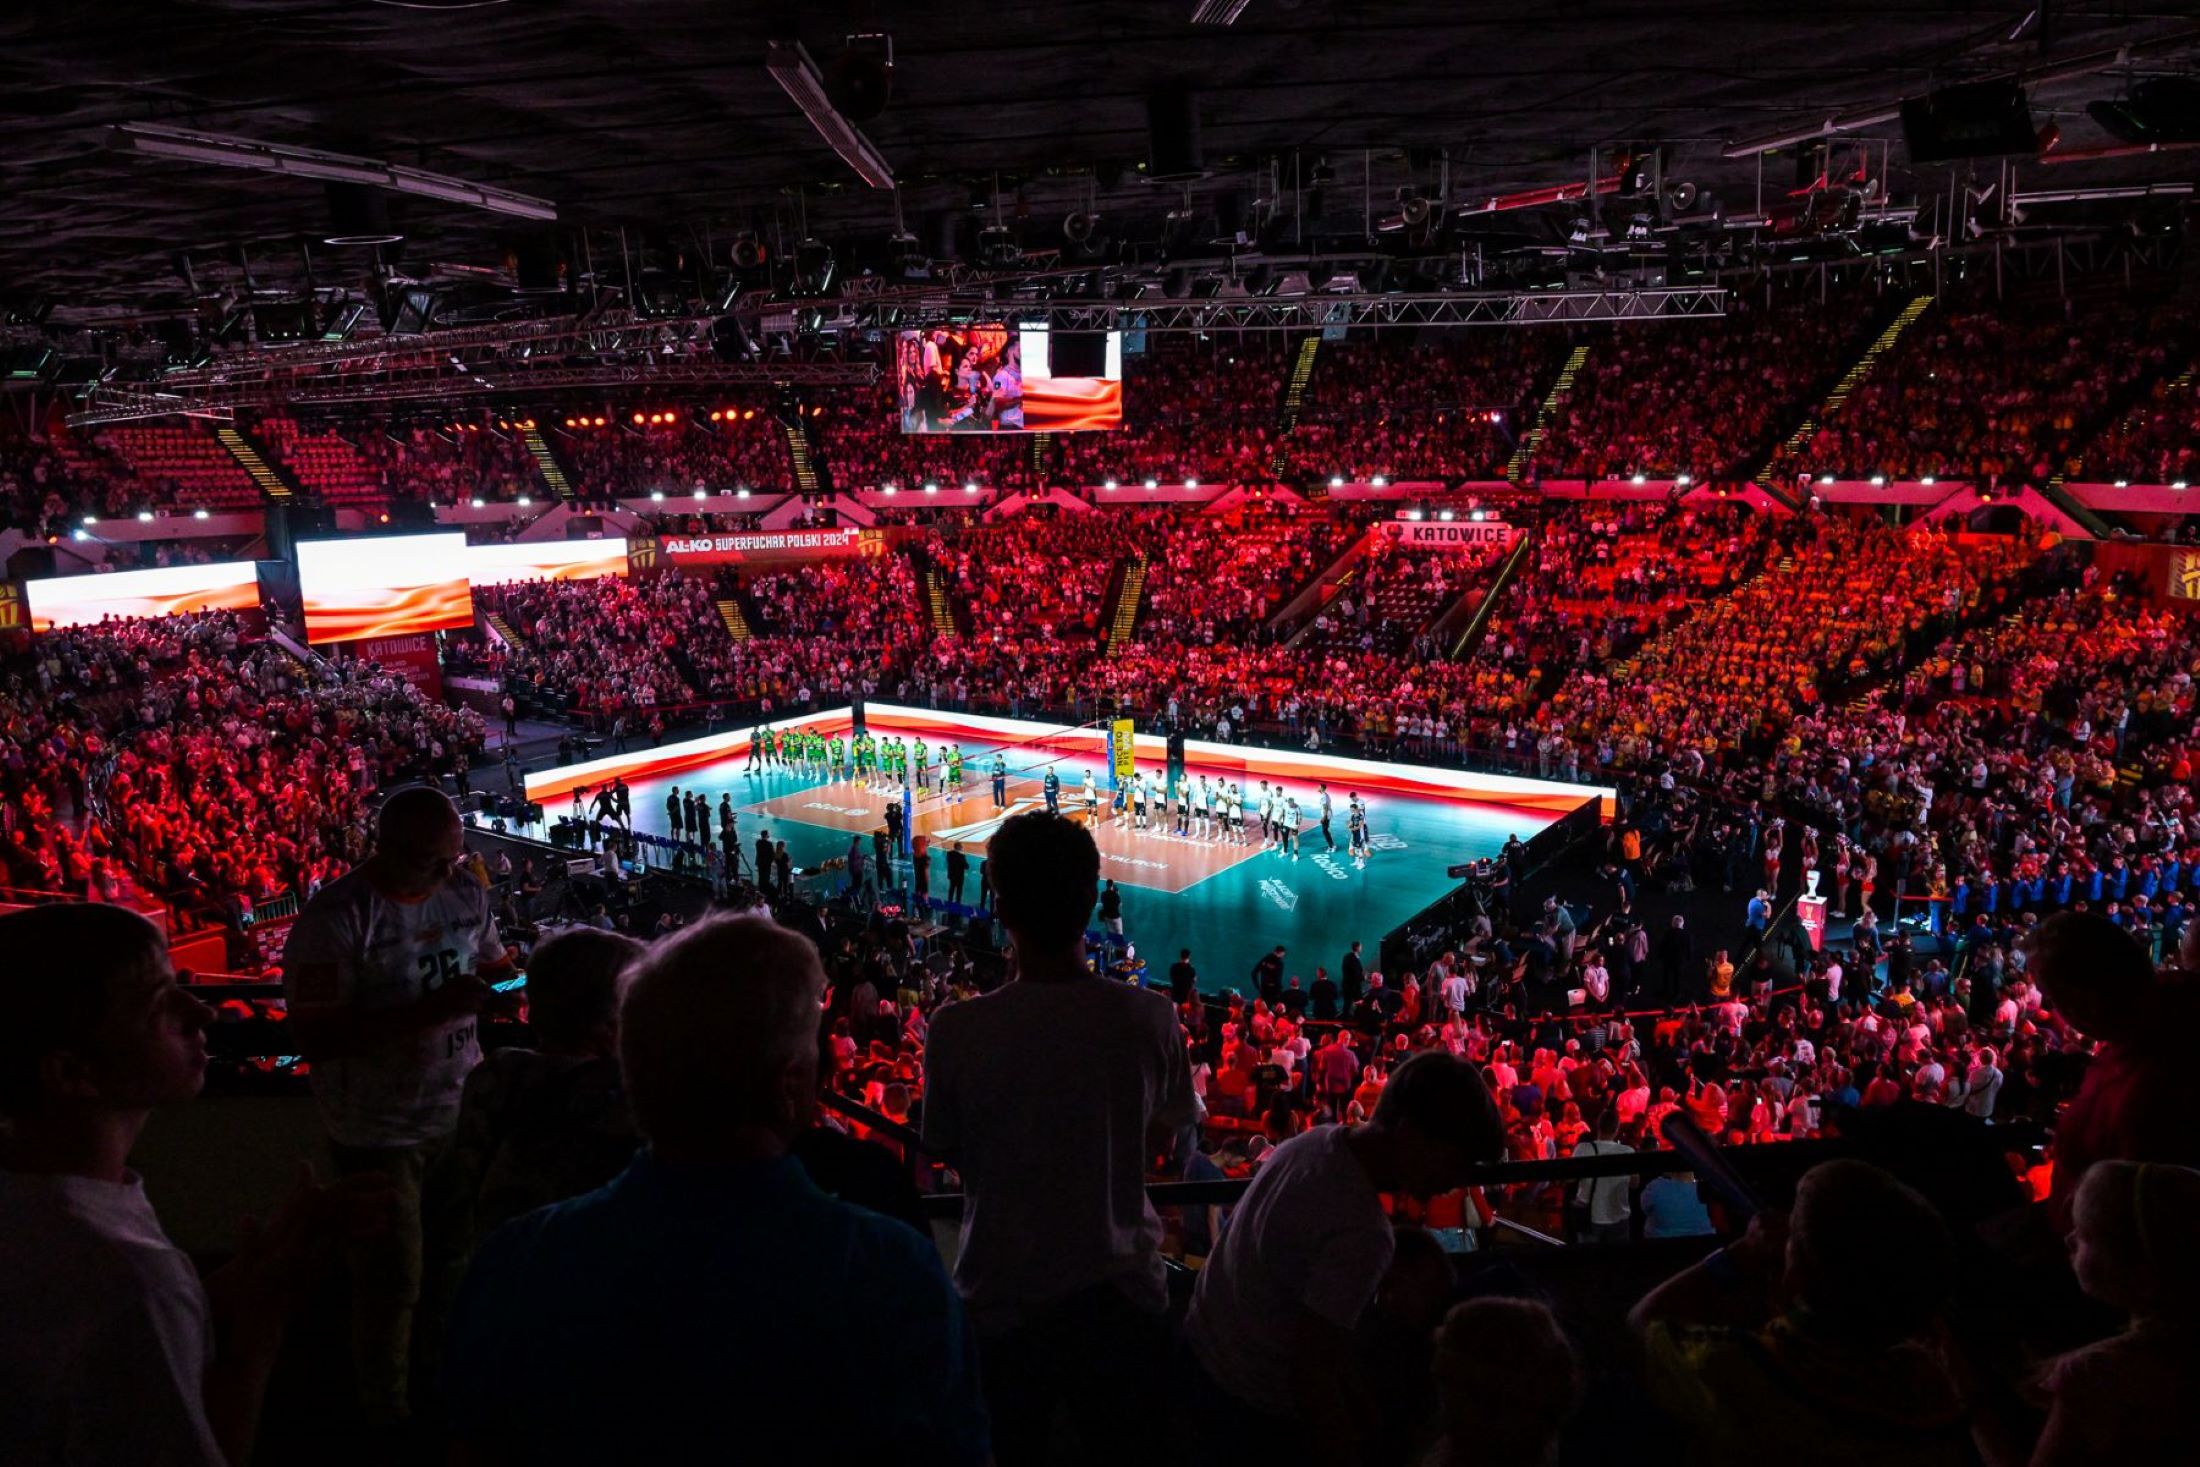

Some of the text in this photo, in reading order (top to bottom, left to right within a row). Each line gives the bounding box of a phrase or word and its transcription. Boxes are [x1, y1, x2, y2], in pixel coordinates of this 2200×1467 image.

[666, 538, 713, 554] AL-KO
[787, 533, 821, 548] POLSKI
[823, 532, 849, 547] 2024
[1413, 527, 1507, 542] KATOWICE
[366, 636, 427, 656] KATOWICE
